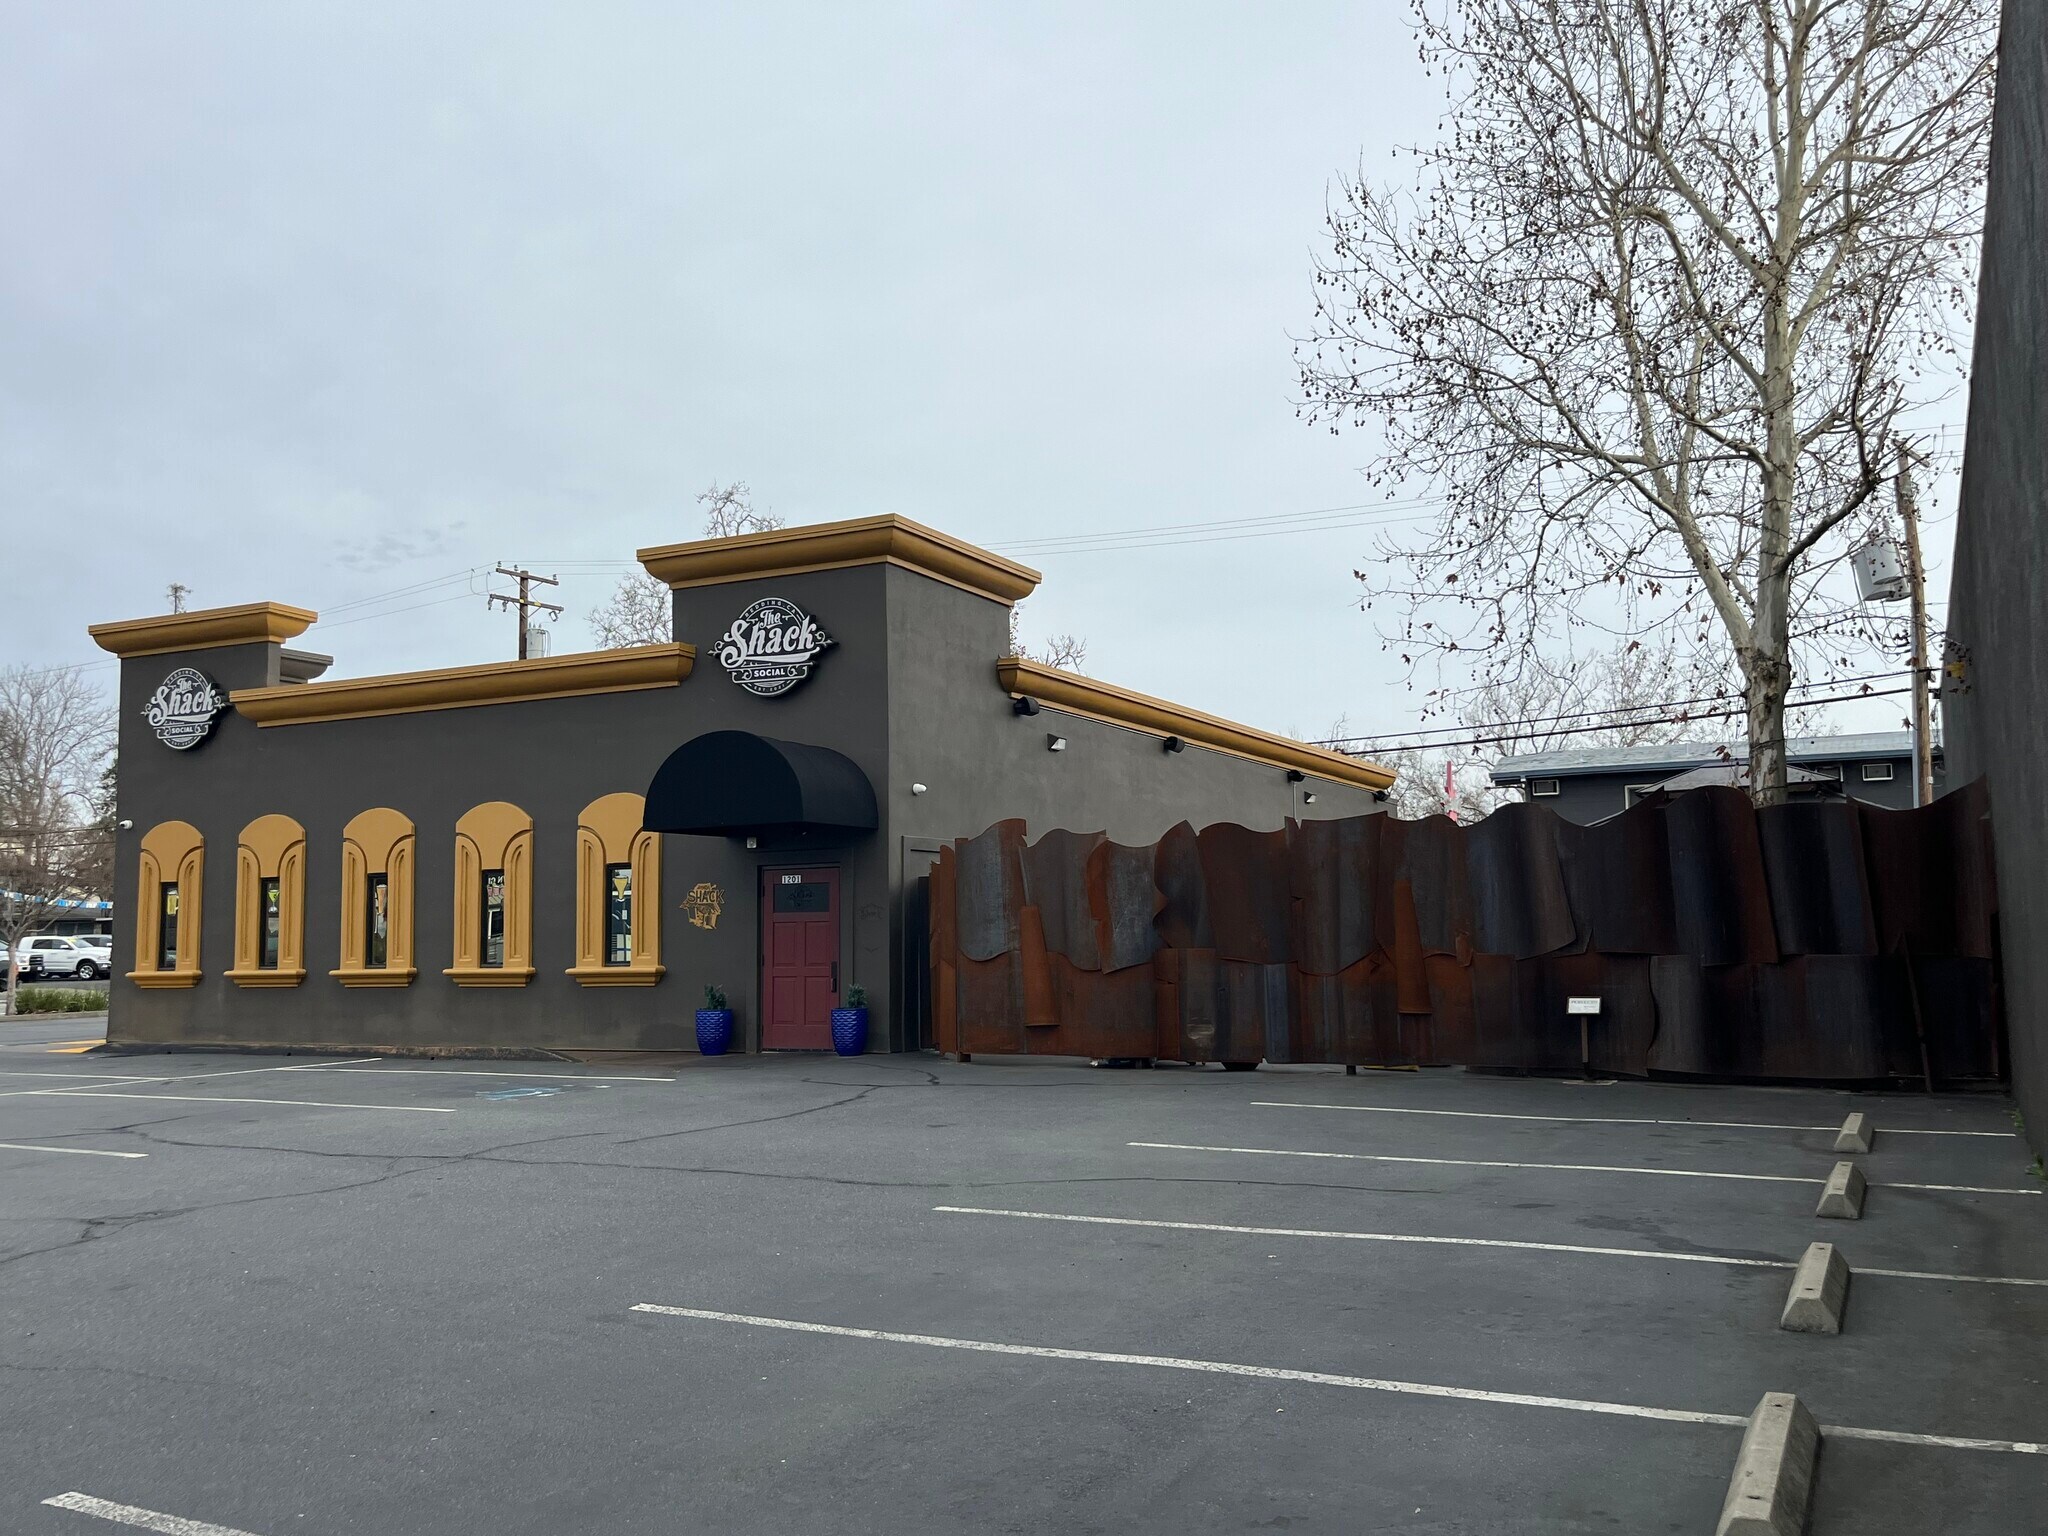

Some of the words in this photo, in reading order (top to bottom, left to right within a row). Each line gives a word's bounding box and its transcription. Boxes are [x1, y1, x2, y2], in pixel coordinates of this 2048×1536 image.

[760, 609, 783, 630] The
[720, 615, 818, 669] Shack
[753, 668, 786, 678] SOCIAL
[176, 677, 193, 693] The
[148, 683, 217, 726] Shack
[171, 726, 193, 734] SOCIAL
[783, 875, 800, 884] 1201
[687, 889, 726, 904] SHACK
